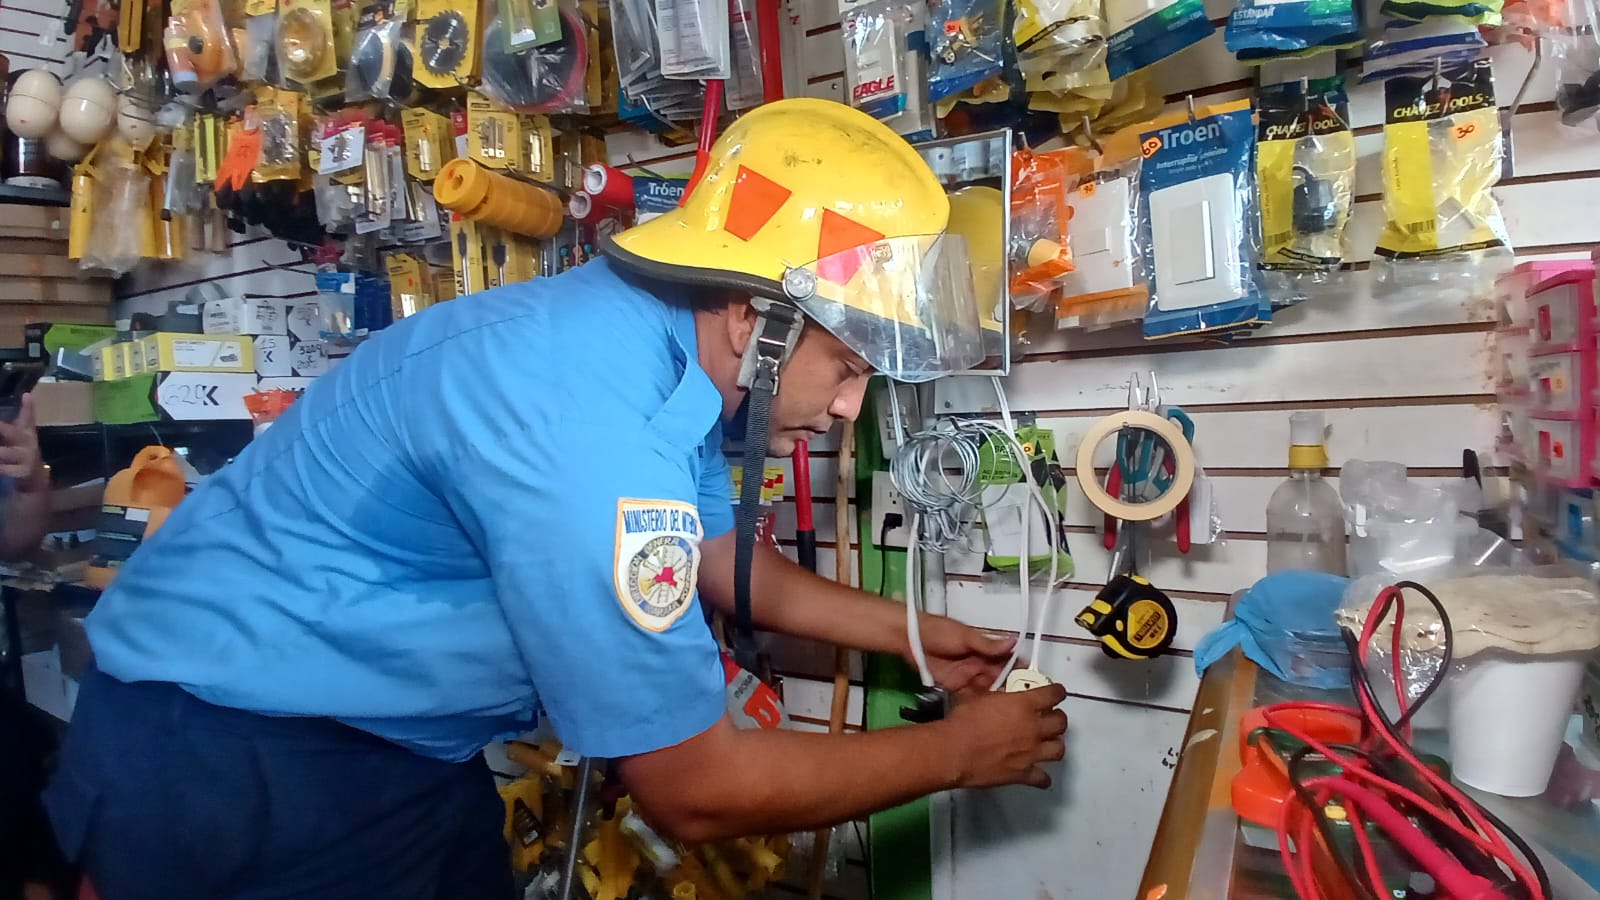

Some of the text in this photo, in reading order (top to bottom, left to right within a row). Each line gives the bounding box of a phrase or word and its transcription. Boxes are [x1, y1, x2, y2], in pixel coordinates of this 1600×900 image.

[853, 74, 895, 100] EAGLE
[1442, 93, 1484, 114] OOLS
[1159, 123, 1220, 149] Troen
[623, 509, 667, 533] MINISTERIO
[669, 508, 681, 532] DEL
